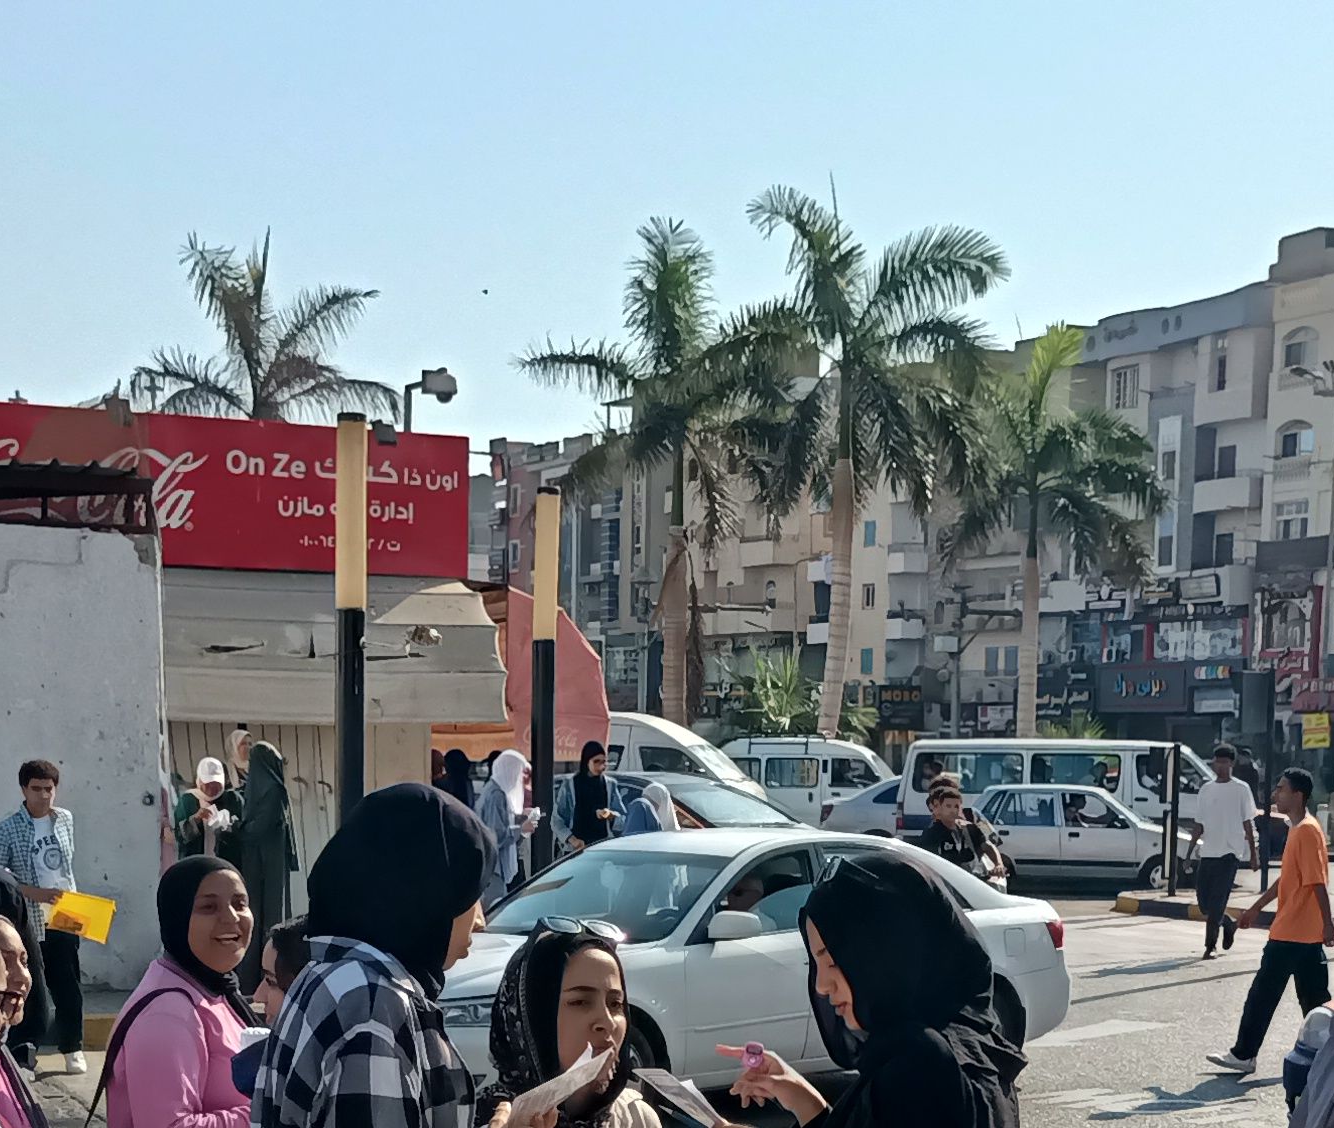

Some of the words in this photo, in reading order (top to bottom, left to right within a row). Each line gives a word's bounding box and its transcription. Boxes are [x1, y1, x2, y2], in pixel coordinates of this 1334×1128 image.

[226, 449, 265, 476] On
[272, 453, 307, 479] Ze
[314, 456, 399, 484] كك
